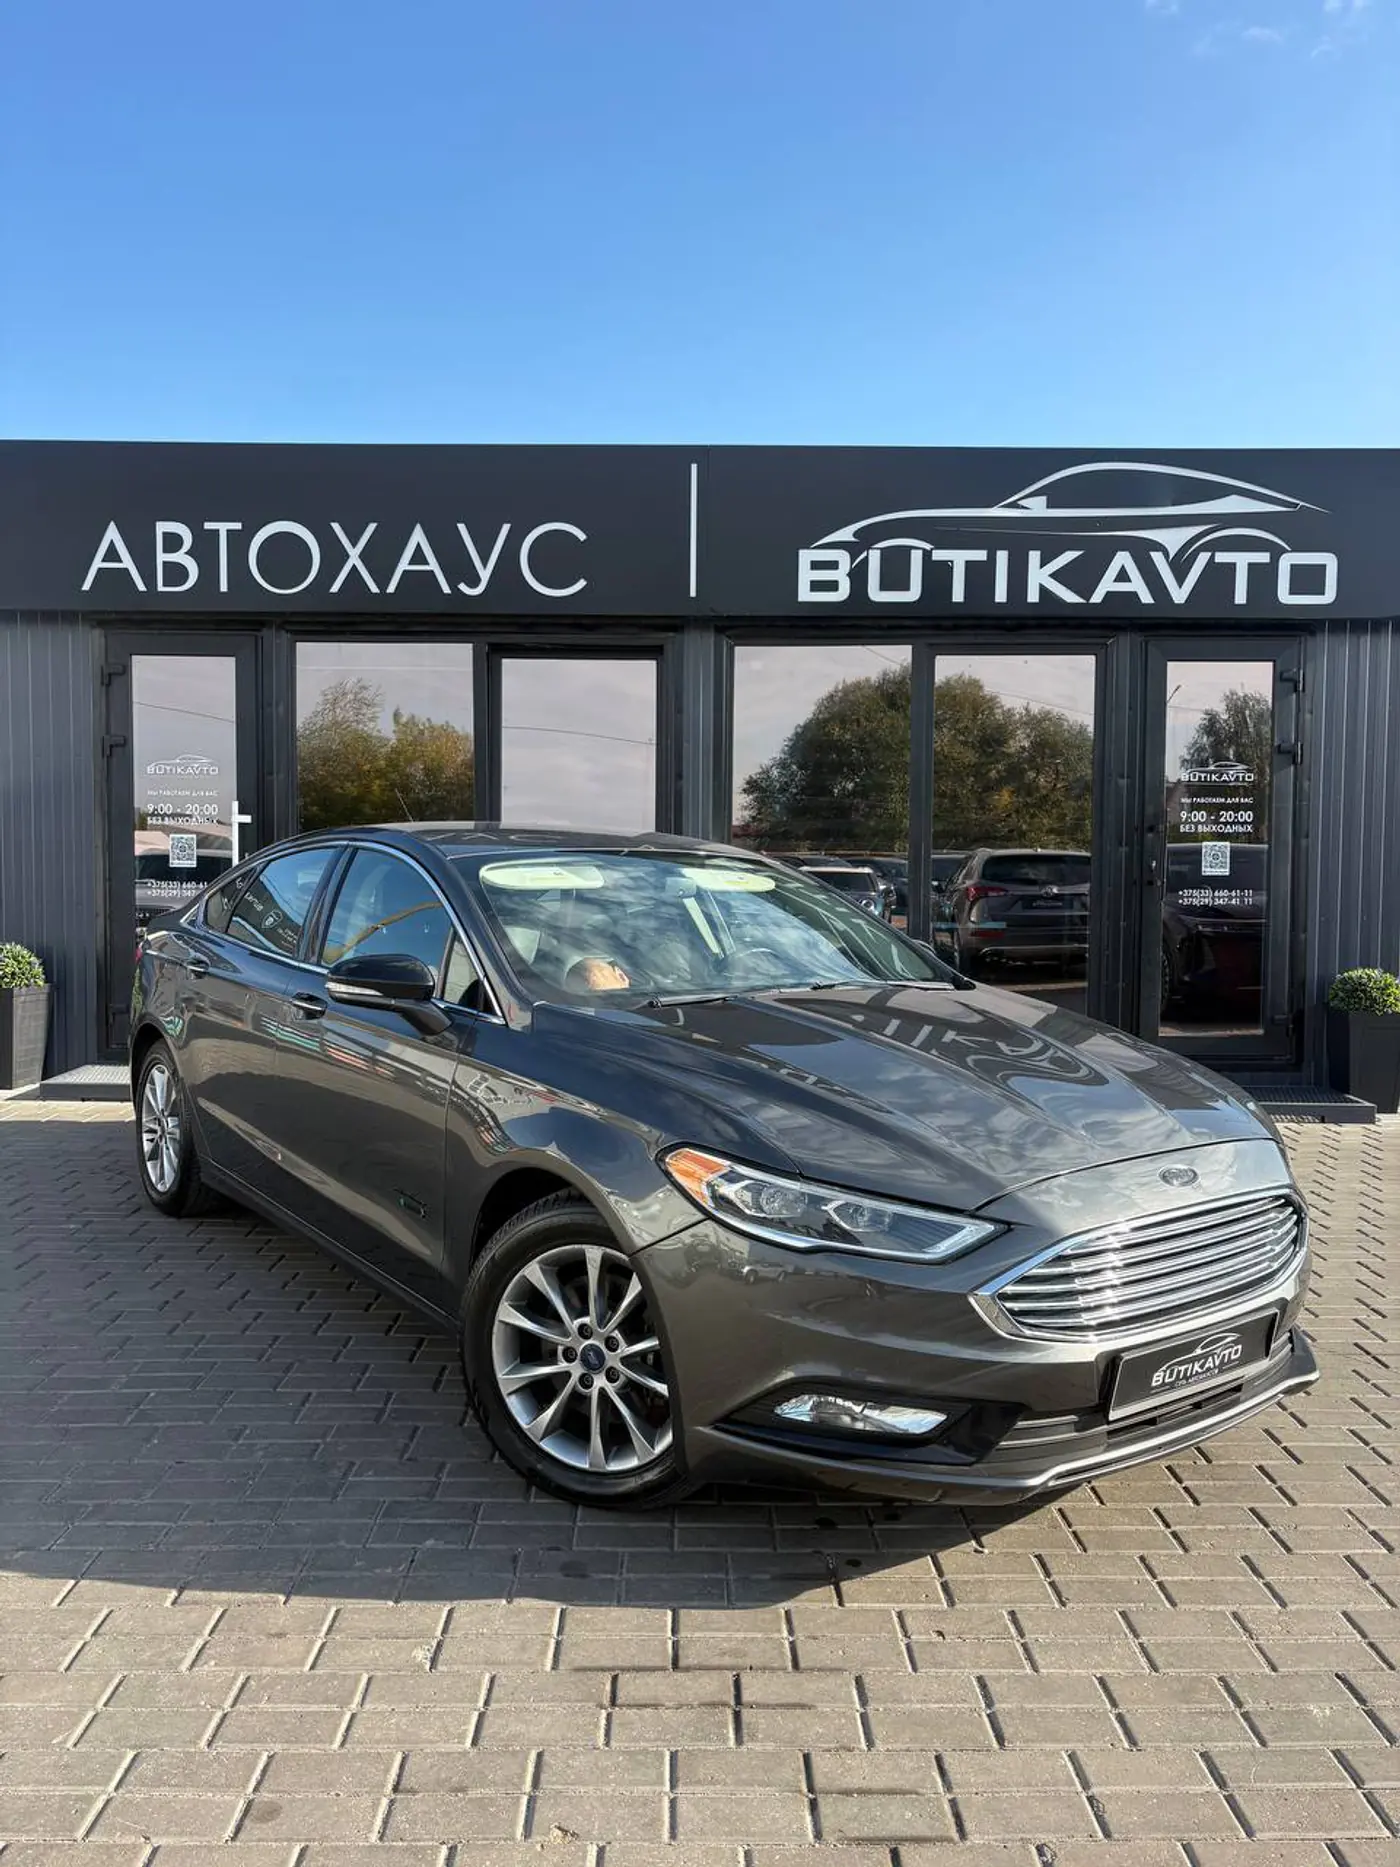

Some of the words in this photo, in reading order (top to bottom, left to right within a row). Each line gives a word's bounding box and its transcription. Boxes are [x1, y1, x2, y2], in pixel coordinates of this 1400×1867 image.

[82, 520, 588, 597] АВТОХАУС
[798, 549, 1338, 605] BUTIKAVTO
[147, 765, 218, 775] BUTIKAVTO
[1181, 772, 1254, 782] BUTIKAVTO
[147, 803, 173, 815] 9:00
[185, 803, 218, 815] 20:00
[1180, 811, 1207, 822] 9:00
[1219, 811, 1253, 822] 20:00
[1180, 824, 1195, 832] БЕЗ
[1197, 824, 1253, 832] ВЫХОДНЫХ
[1214, 898, 1253, 906] 347-4111
[1151, 1344, 1242, 1387] BUTIKAVTO
